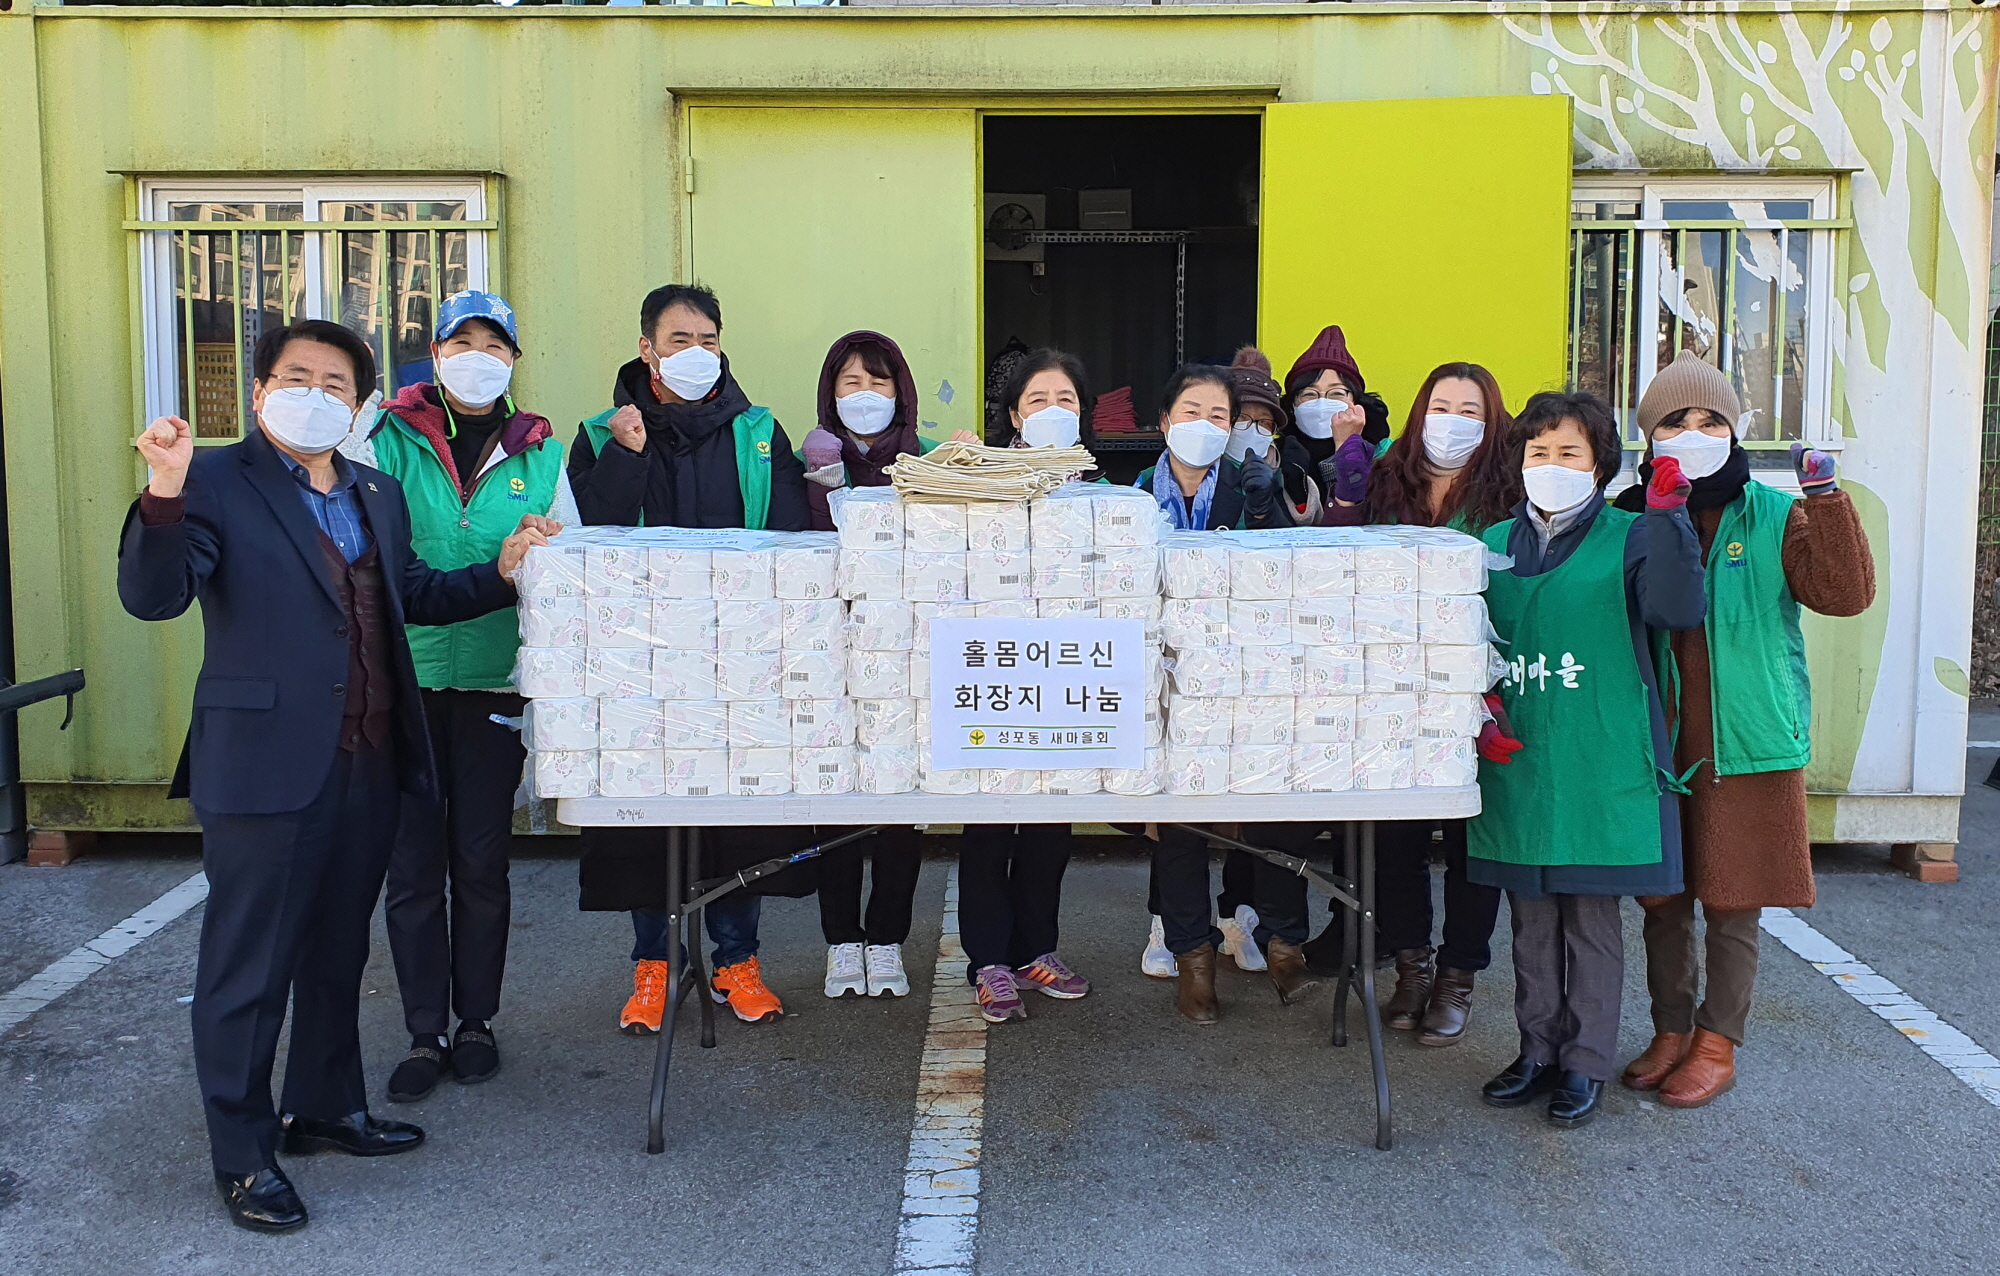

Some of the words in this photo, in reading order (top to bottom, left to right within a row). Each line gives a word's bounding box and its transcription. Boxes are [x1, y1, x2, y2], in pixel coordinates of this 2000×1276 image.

[507, 491, 529, 502] SMU
[962, 639, 1113, 668] 홀몸어르신
[954, 683, 1041, 712] 화장지
[1065, 684, 1122, 713] 나눔
[997, 730, 1040, 745] 성포동
[1050, 730, 1109, 745] 새마을회
